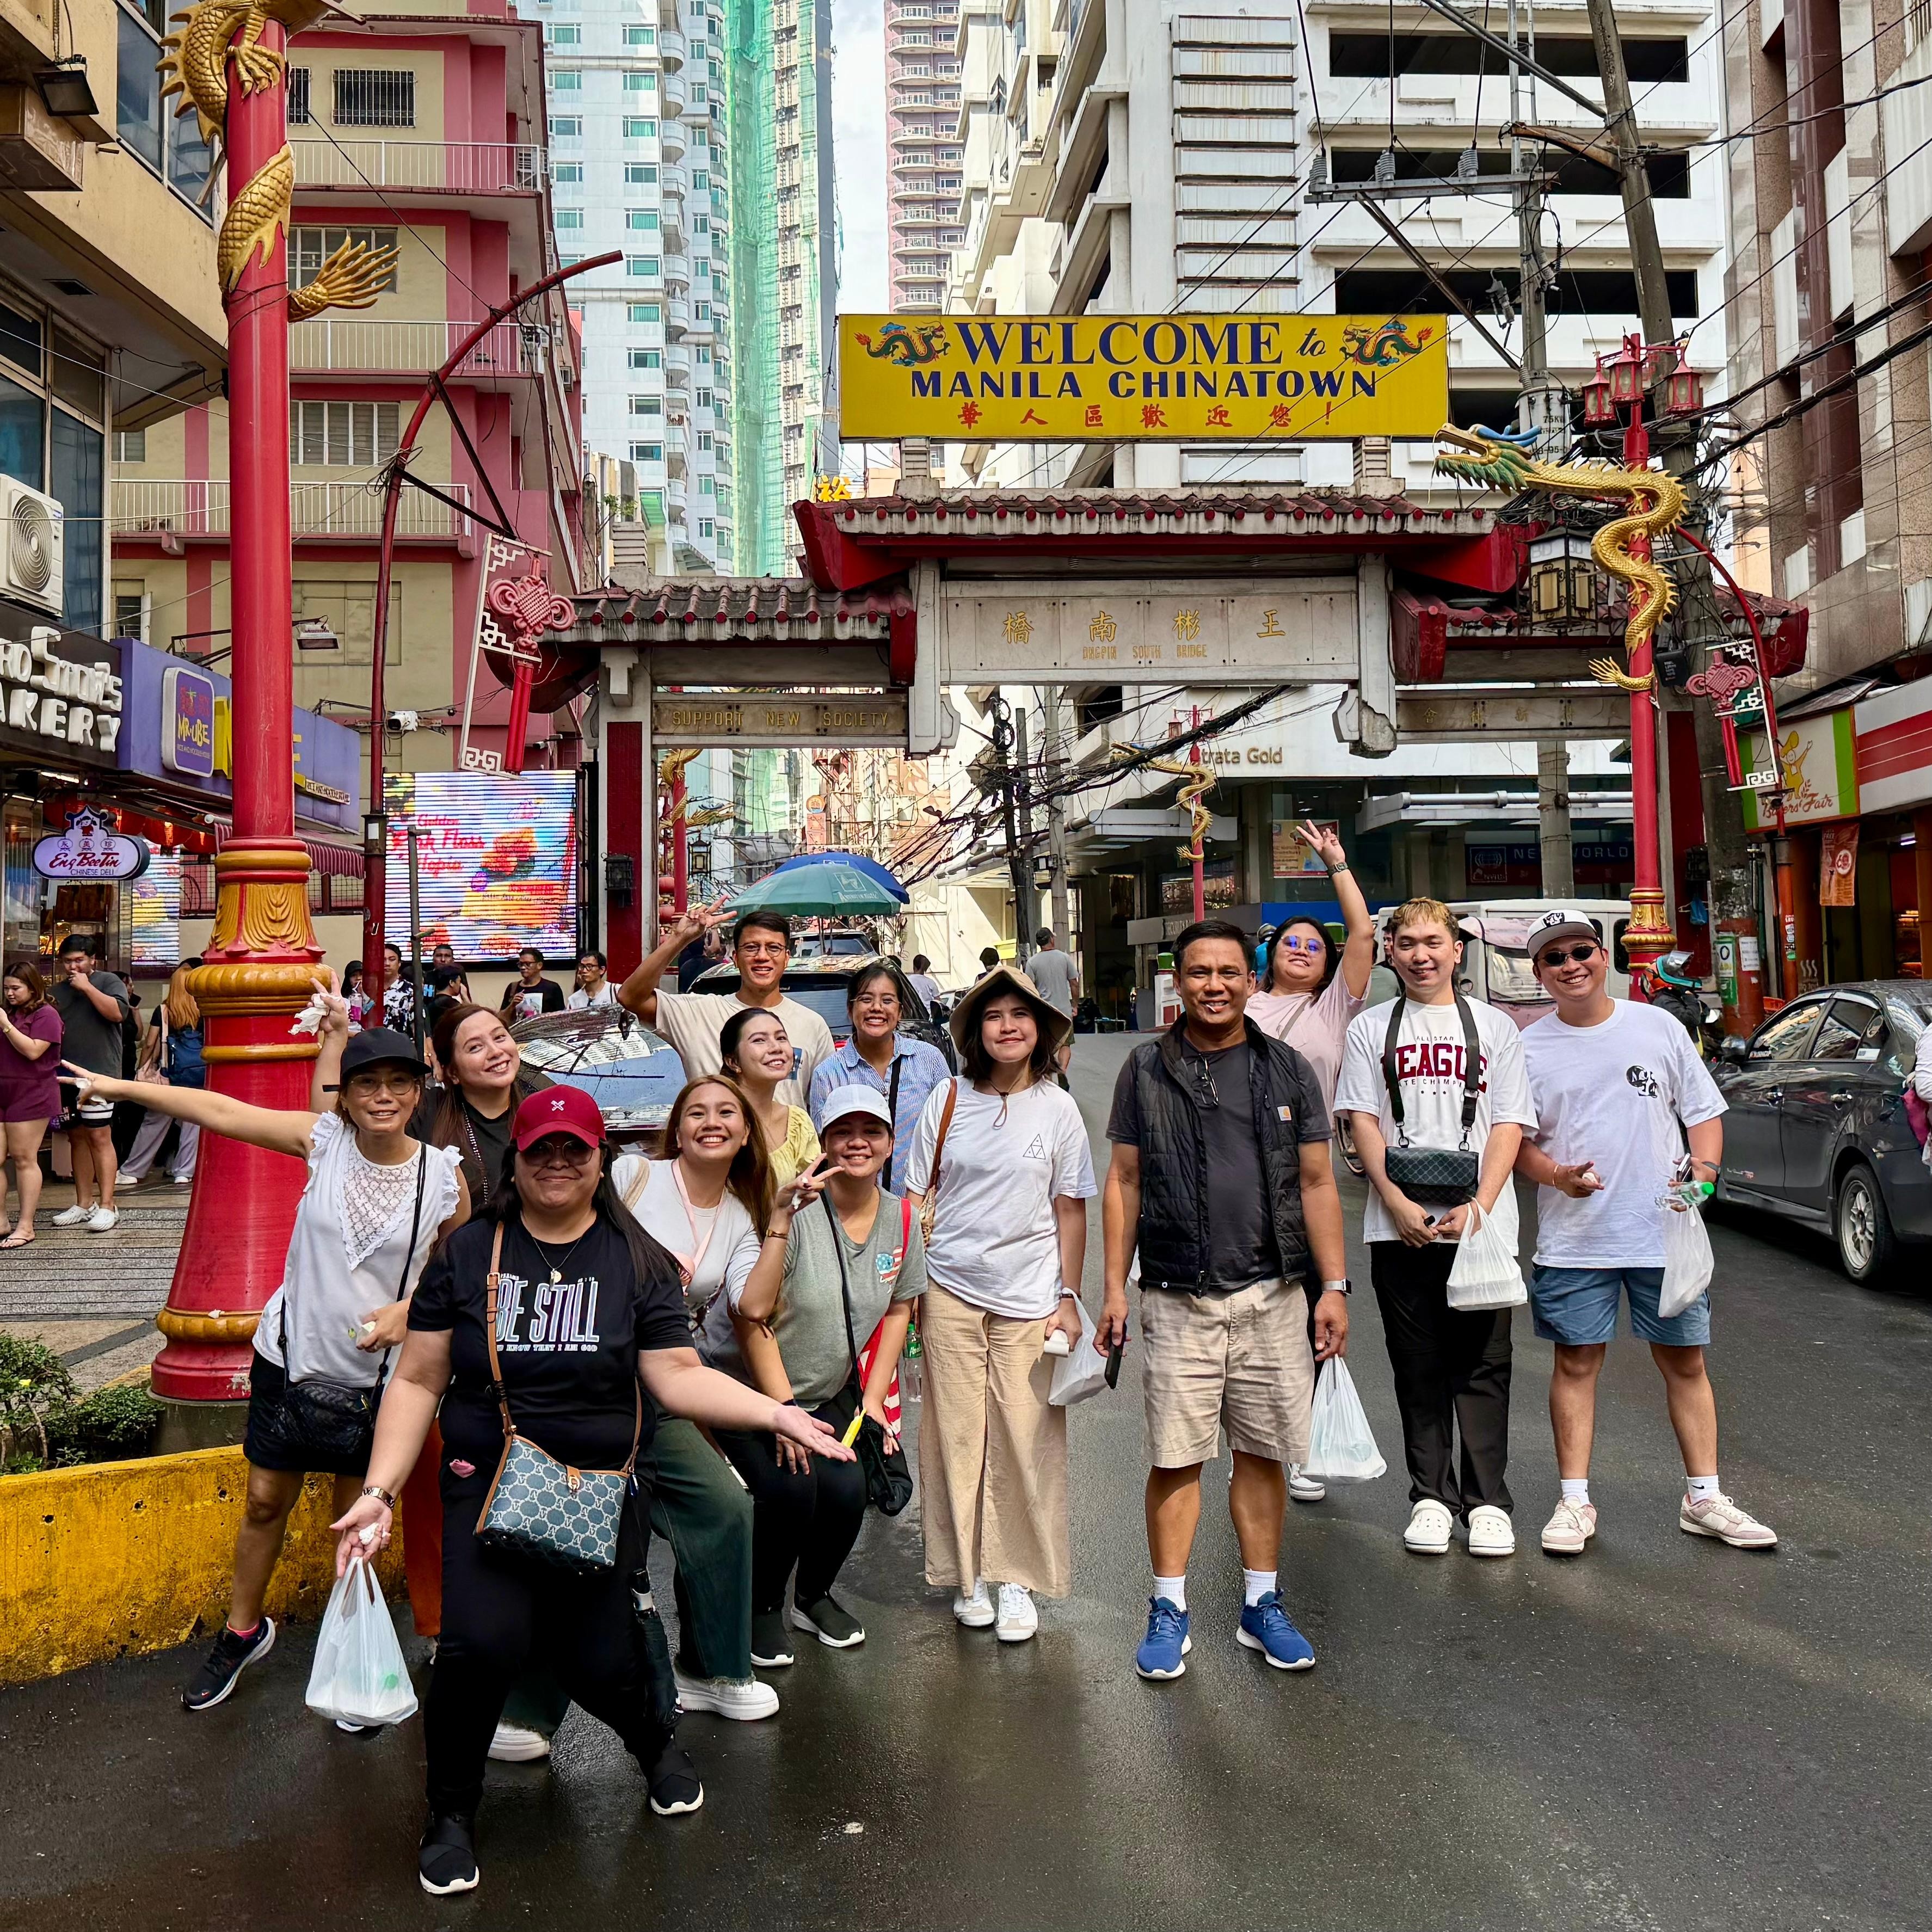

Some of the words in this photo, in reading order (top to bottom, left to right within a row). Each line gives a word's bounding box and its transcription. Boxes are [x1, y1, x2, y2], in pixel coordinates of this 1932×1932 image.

[955, 322, 1283, 365] WELCOME
[1296, 328, 1326, 356] to
[912, 371, 1084, 398] MANILA
[1108, 371, 1376, 398] CHINATOWN
[1132, 644, 1162, 660] SOUTH
[1176, 644, 1208, 659] BRIDGE
[673, 711, 743, 726] SUPPORT
[766, 712, 801, 727] NEW
[823, 712, 889, 727] SOCIETY
[1247, 747, 1283, 764] Gold
[1802, 793, 1833, 813] Fair
[50, 853, 77, 870] Eng
[77, 852, 101, 866] Bee
[101, 852, 121, 867] Tin
[1381, 1043, 1487, 1094] EAGUE
[496, 1279, 528, 1342] BE
[529, 1281, 599, 1343] STILL
